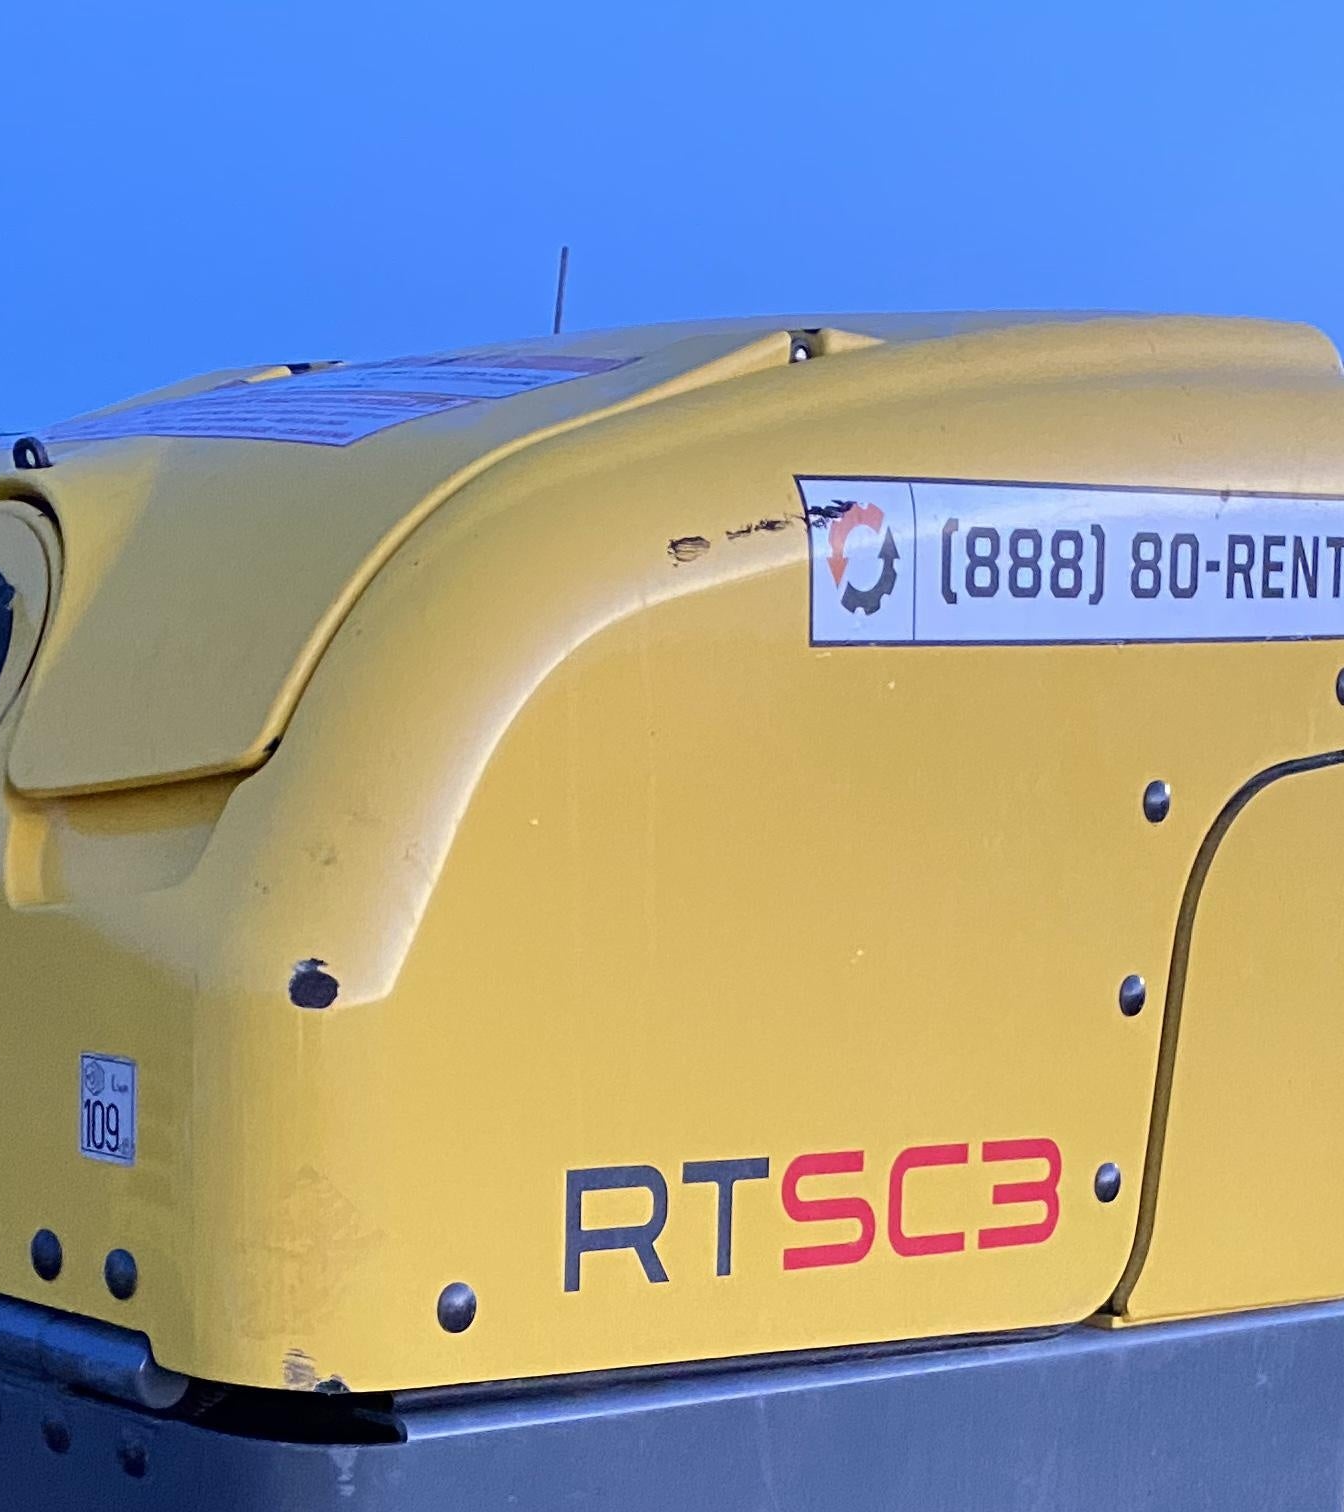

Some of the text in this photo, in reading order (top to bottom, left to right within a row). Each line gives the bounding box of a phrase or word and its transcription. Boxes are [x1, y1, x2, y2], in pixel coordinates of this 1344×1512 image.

[942, 518, 1105, 604] (888)
[84, 1099, 119, 1152] 109
[564, 1138, 1062, 1293] RTSC3
